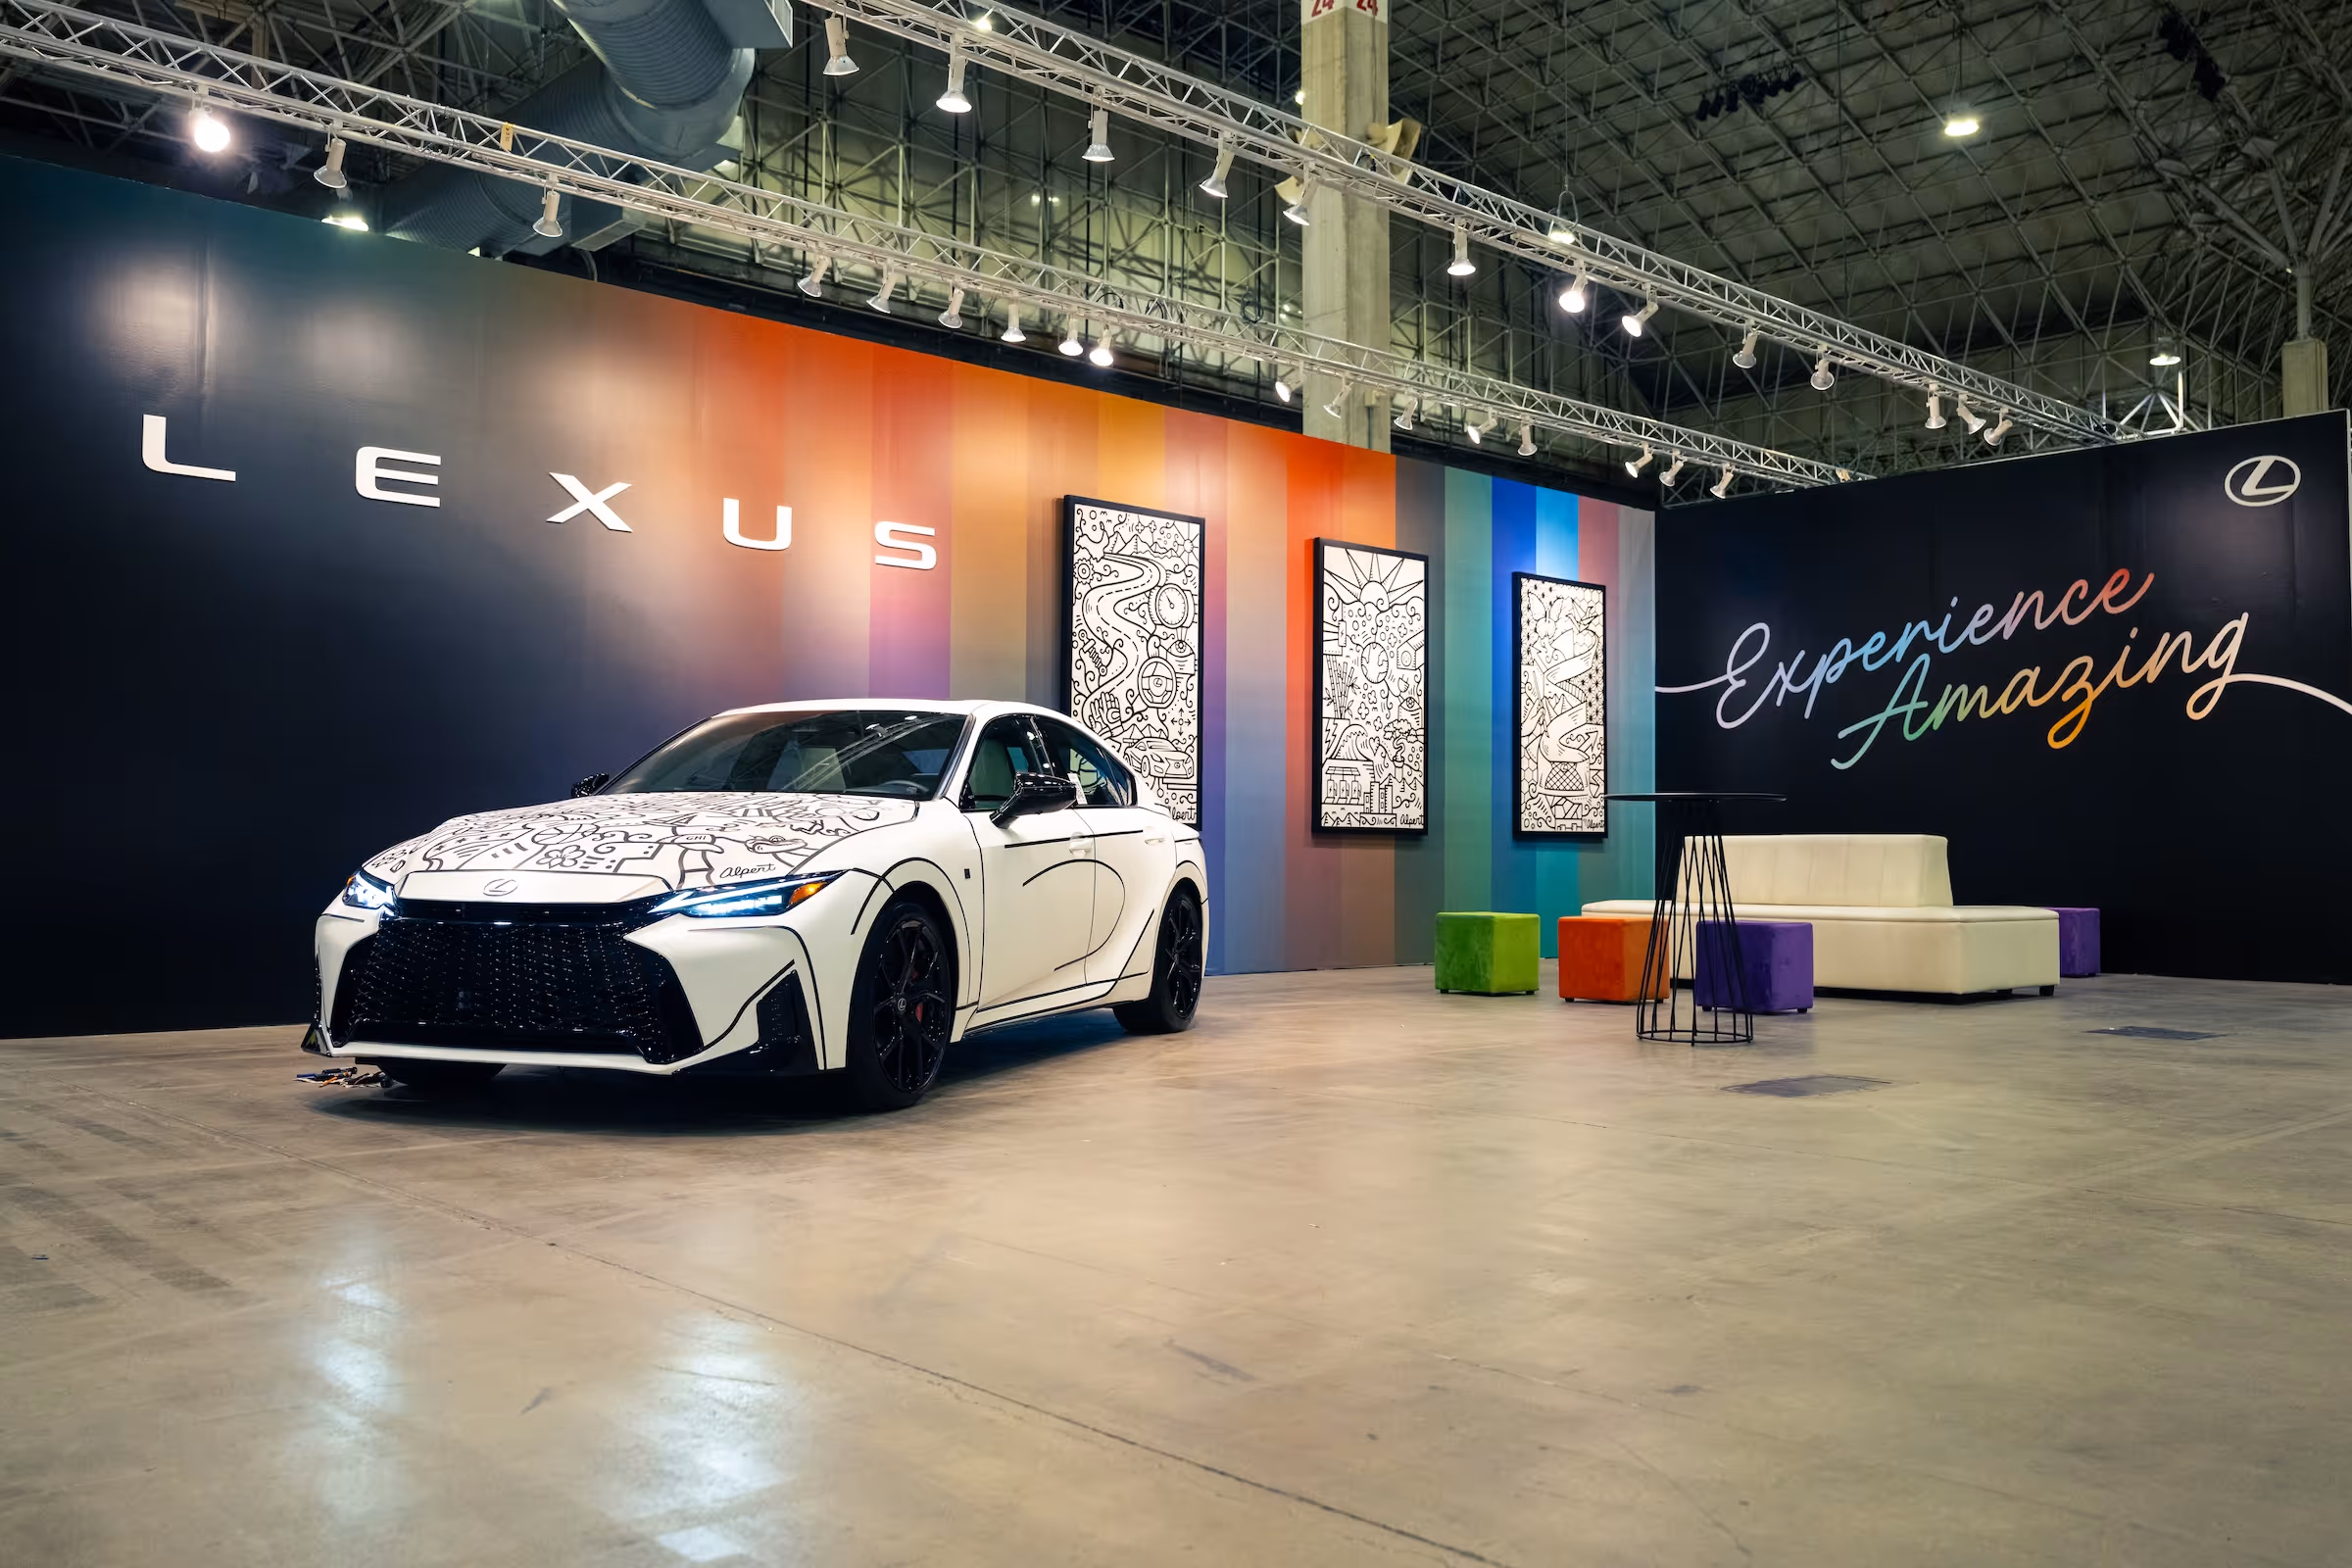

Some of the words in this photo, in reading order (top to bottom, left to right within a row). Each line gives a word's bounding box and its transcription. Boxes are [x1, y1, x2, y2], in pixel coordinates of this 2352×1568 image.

[141, 414, 939, 571] LEXUS
[1716, 567, 2155, 730] Experience
[1830, 612, 2249, 770] Amazing
[719, 863, 776, 879] Alpert
